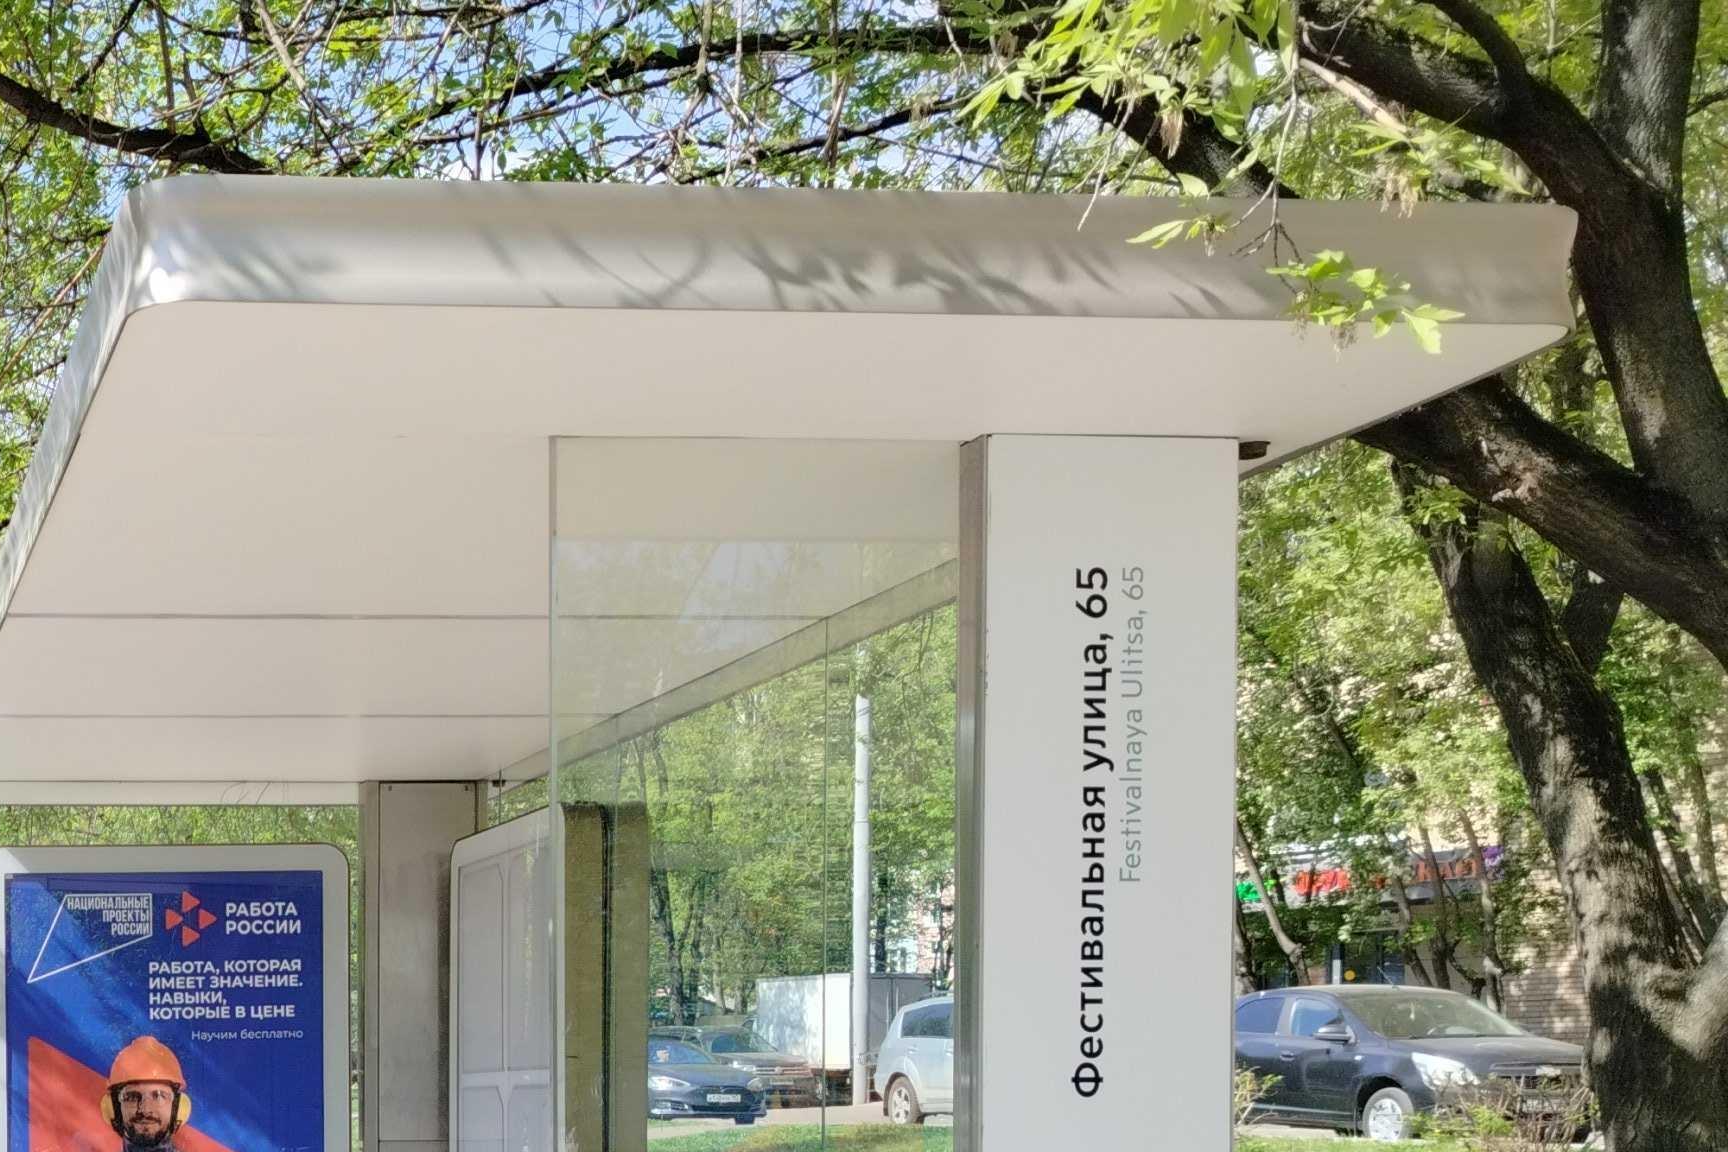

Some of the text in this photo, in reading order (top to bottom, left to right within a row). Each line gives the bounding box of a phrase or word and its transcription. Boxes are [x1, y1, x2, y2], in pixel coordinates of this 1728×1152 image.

[1119, 566, 1148, 883] Festivalnaya Ulitsa, 65
[1071, 566, 1114, 1098] Фестивальная улица, 65
[67, 896, 149, 910] НАЦИОНАЛЬНЫЕ
[225, 902, 298, 917] РАБОТА
[102, 909, 150, 922] ПРОЕКТЫ
[111, 922, 150, 936] РОССИИ
[225, 920, 302, 935] РОССИИ
[148, 959, 302, 976] РАБОТА, КОТОРАЯ
[148, 974, 304, 990] ИМЕЕТ ЗНАЧЕНИЕ.
[149, 991, 227, 1006] НАВЫКИ,
[149, 1005, 296, 1021] КОТОРЫЕ В ЦЕНЕ
[191, 1028, 304, 1042] Научим бесплатно
